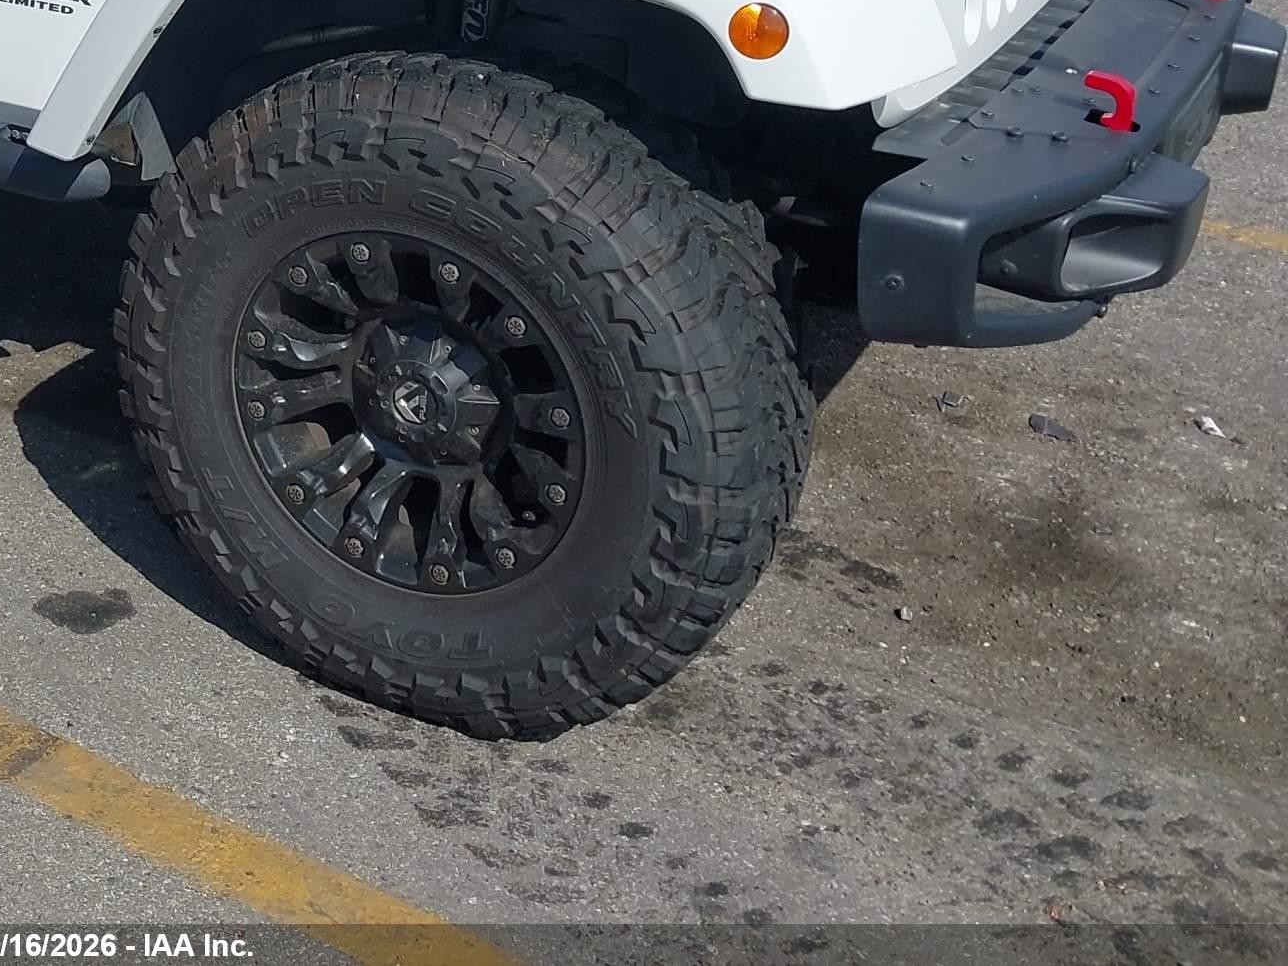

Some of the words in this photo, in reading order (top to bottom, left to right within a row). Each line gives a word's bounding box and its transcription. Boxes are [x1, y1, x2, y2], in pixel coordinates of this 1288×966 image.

[240, 177, 387, 239] OPEN
[408, 186, 639, 441] COUNTRY
[307, 590, 493, 661] TOYO
